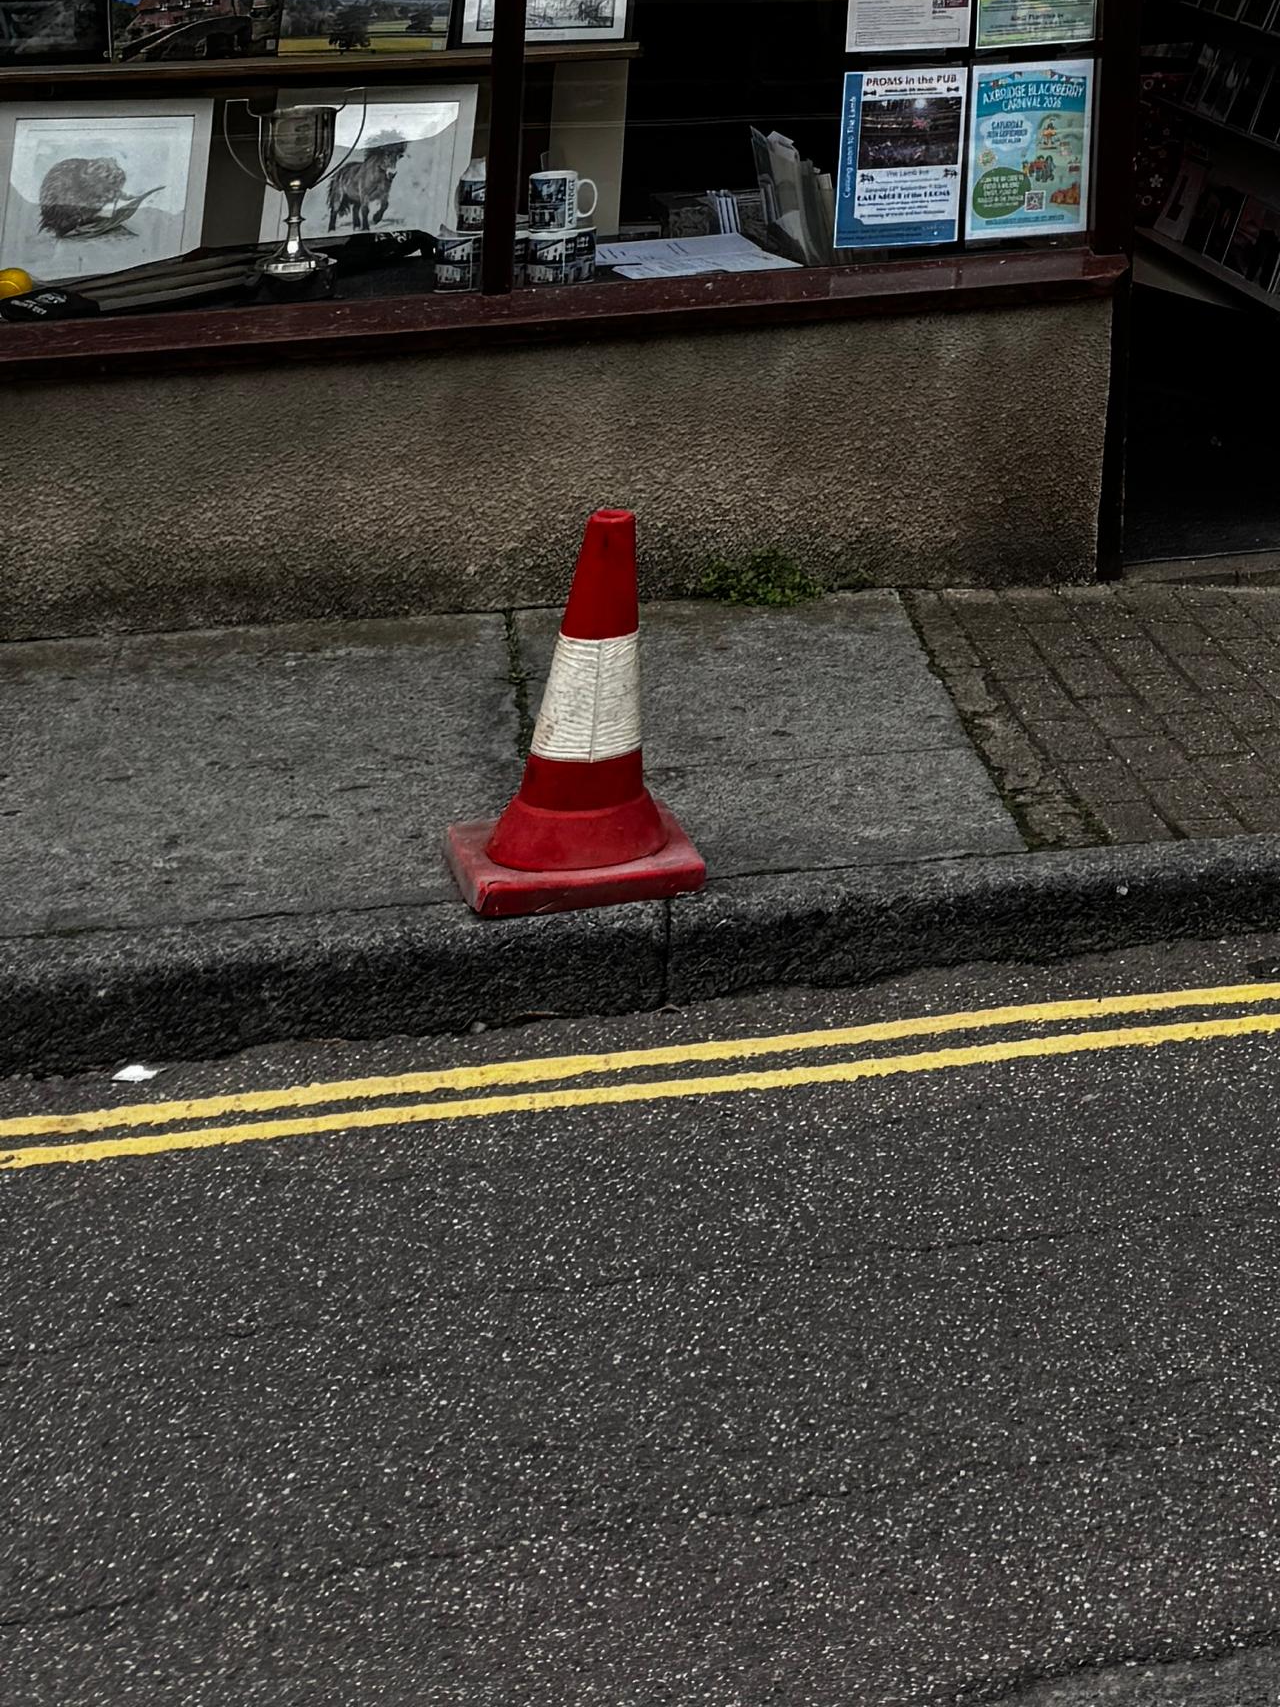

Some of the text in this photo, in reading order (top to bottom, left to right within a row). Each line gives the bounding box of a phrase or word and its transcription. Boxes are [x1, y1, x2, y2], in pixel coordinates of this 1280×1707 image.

[866, 73, 957, 87] PROMS in the PUB
[983, 82, 1085, 105] AXBRIDGE BLACKBERRY
[1002, 96, 1062, 111] CARNIVAL 2026
